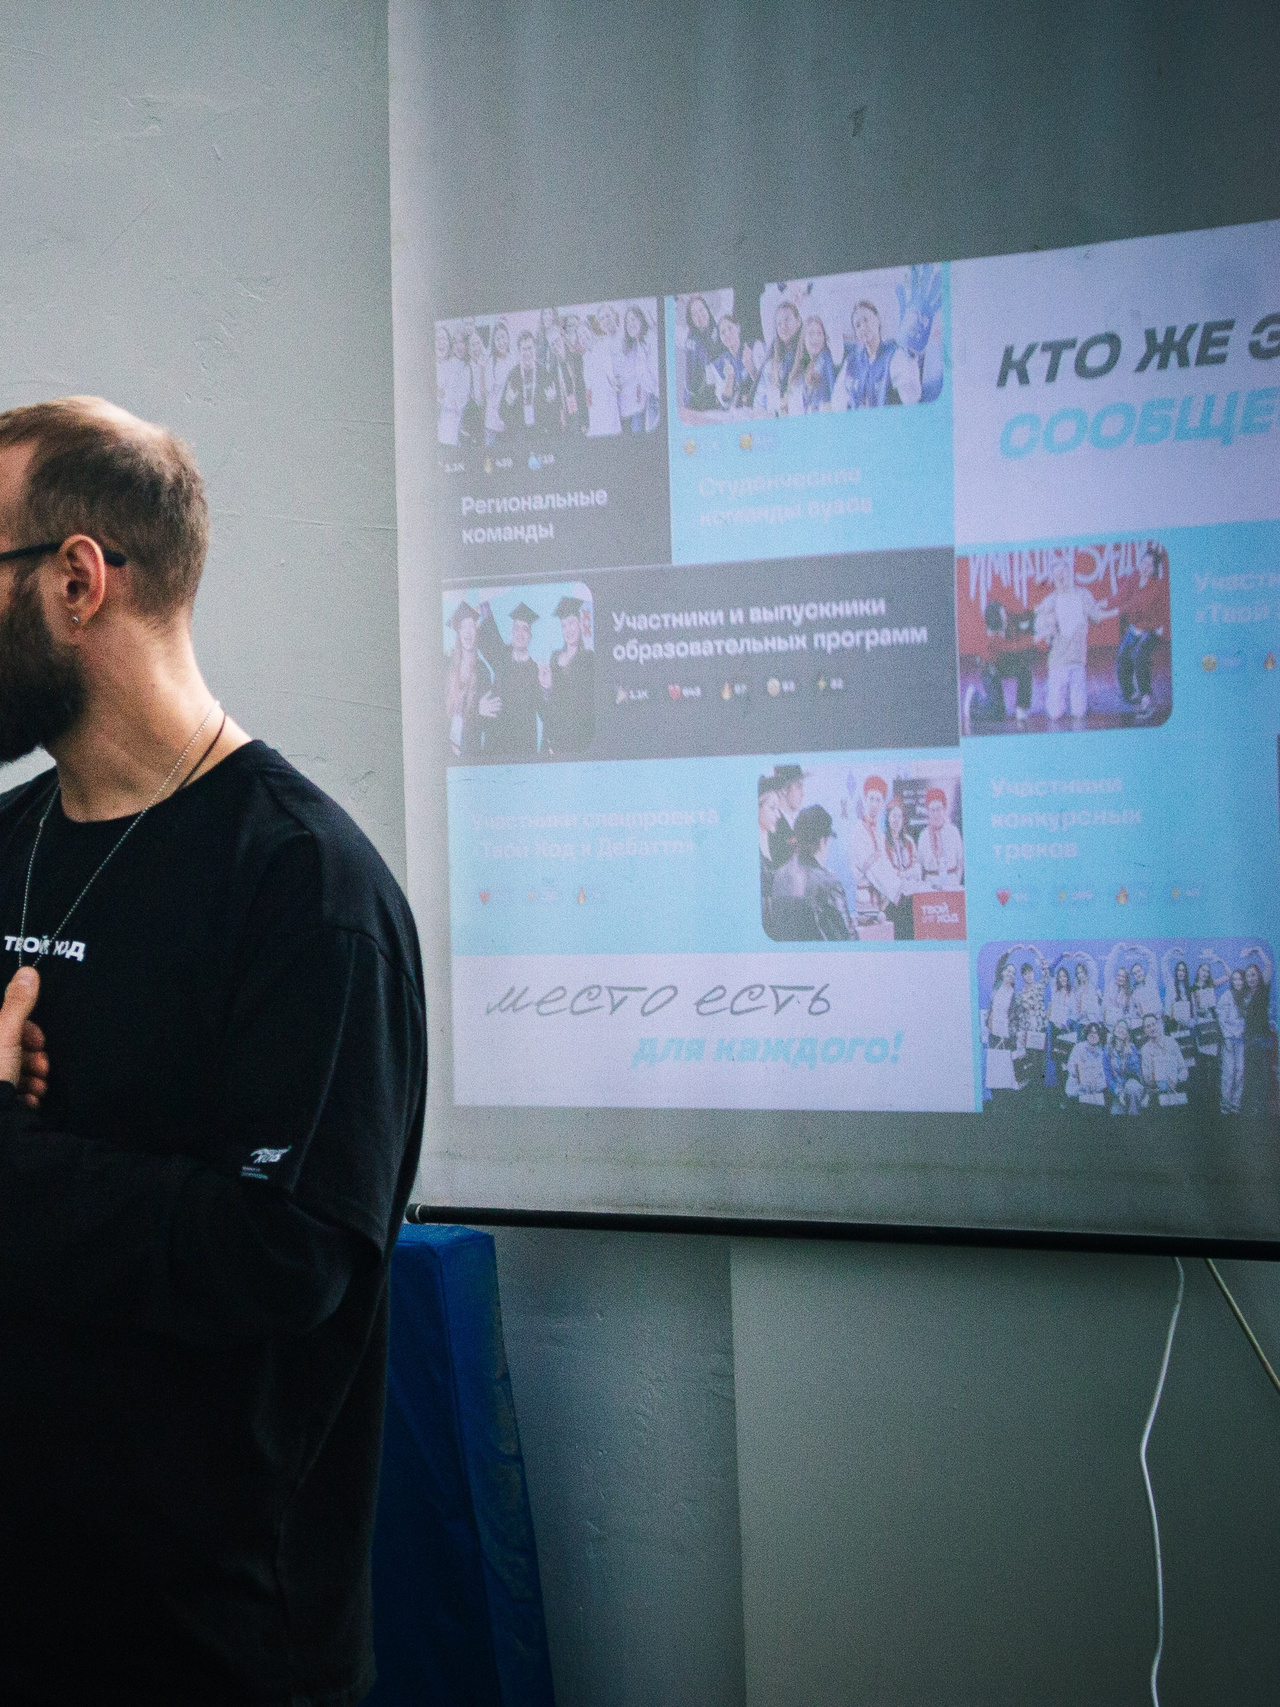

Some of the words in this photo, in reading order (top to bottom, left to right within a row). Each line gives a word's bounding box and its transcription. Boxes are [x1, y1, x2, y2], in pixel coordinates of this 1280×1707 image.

[996, 331, 1122, 387] КТО
[1133, 318, 1236, 373] ЖЕ
[999, 386, 1280, 459] СООБЩЕ
[461, 487, 608, 516] Региональные
[699, 503, 802, 529] команды
[461, 523, 555, 545] команды
[612, 607, 725, 632] Участники
[729, 608, 744, 625] и
[749, 597, 887, 627] выпускники
[612, 633, 808, 664] образовательных
[813, 626, 928, 653] программ
[991, 777, 1122, 799] Участники
[993, 842, 1079, 862] треков
[630, 1035, 706, 1070] для
[712, 1030, 907, 1070] каждого!
